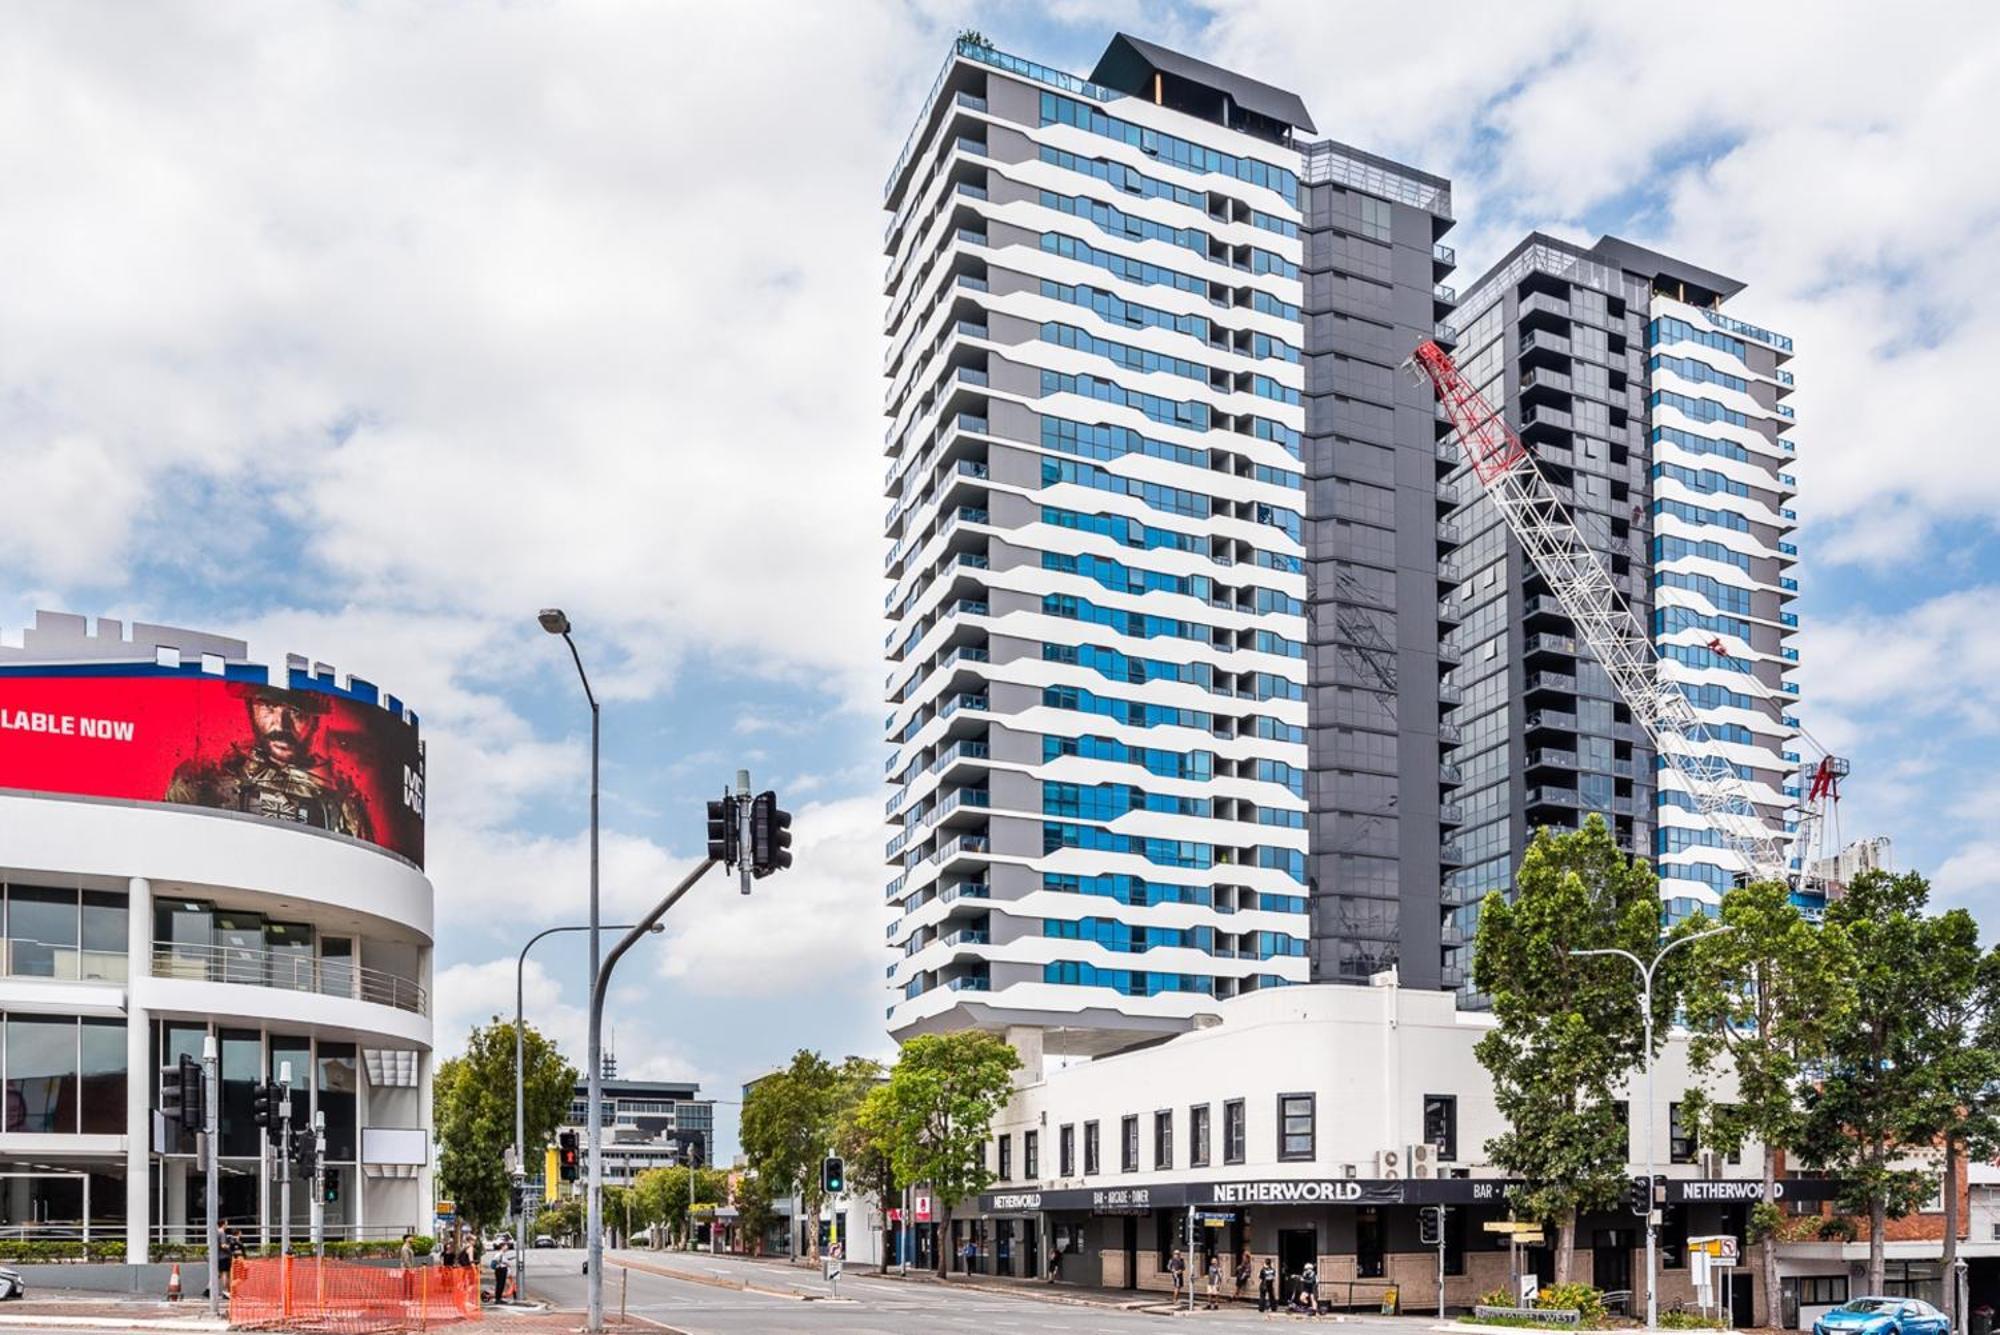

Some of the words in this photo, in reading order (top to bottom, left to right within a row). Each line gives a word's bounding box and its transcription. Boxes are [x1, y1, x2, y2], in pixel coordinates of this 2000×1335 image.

[1, 709, 75, 735] LABLE
[80, 717, 134, 741] NOW
[1213, 1182, 1362, 1201] NETHERWORLD
[1473, 1184, 1493, 1198] BAR
[1683, 1182, 1784, 1199] NETHERWOD
[994, 1193, 1041, 1208] NETHERWORLD
